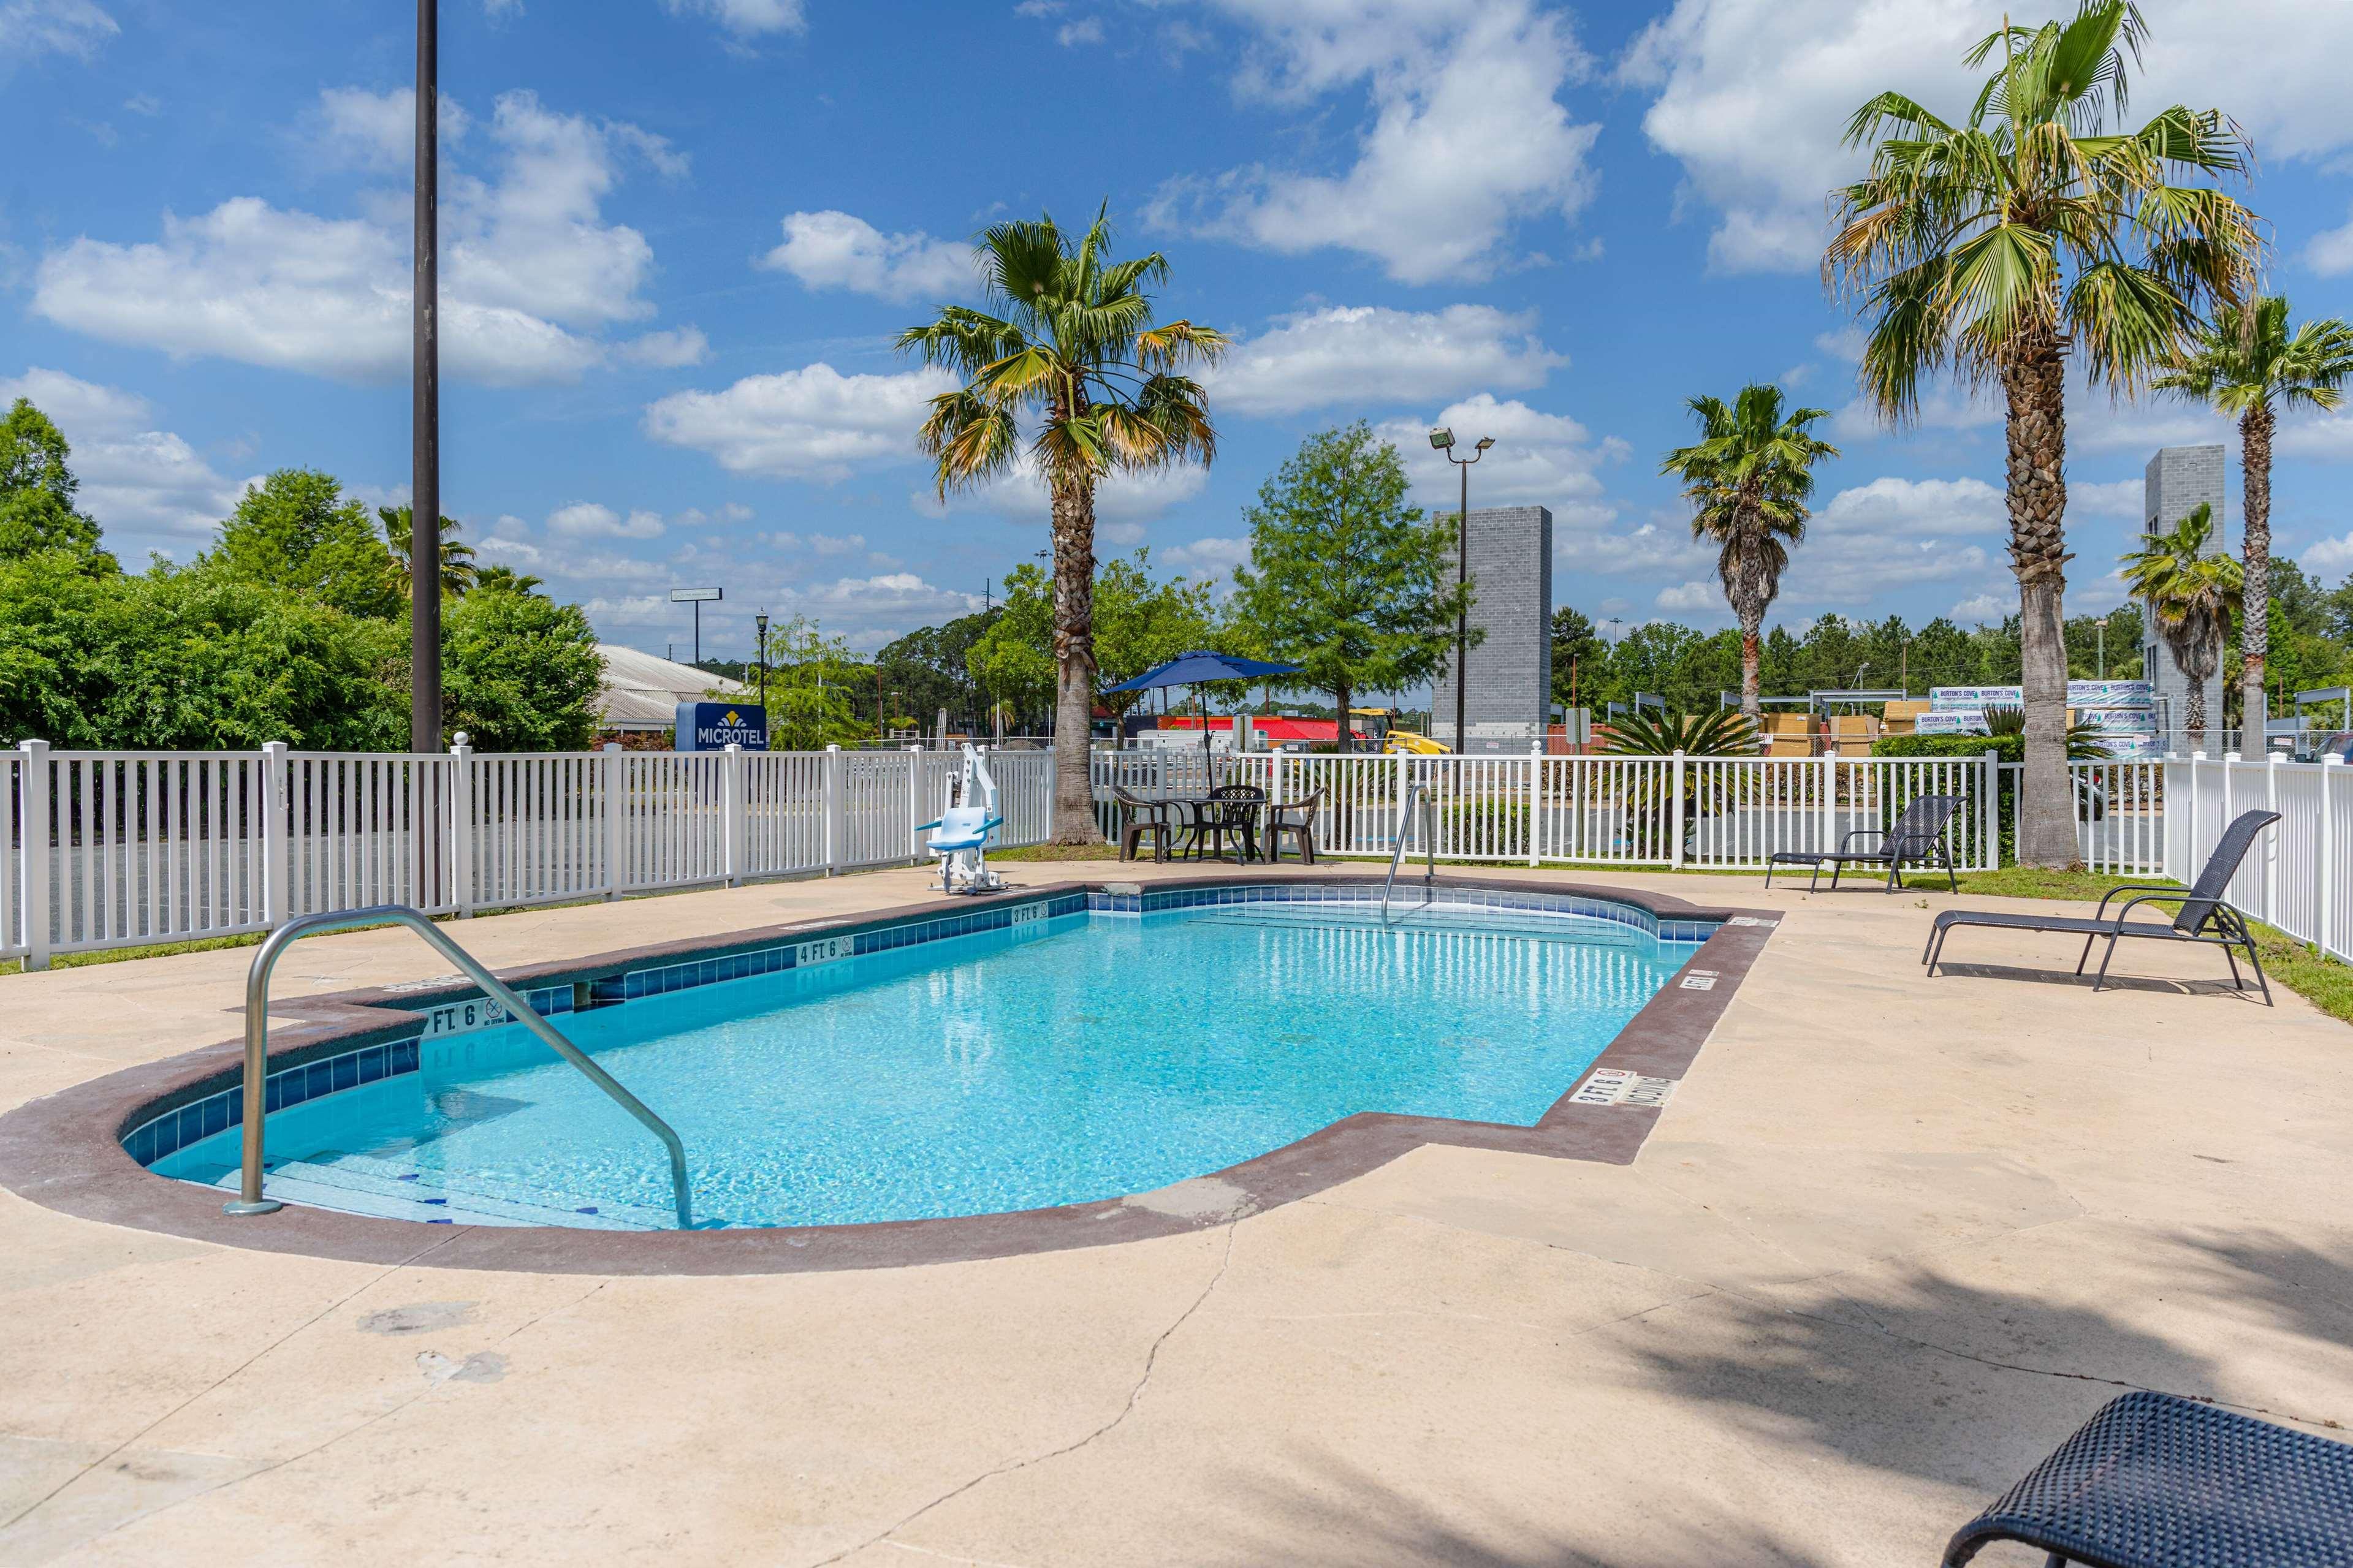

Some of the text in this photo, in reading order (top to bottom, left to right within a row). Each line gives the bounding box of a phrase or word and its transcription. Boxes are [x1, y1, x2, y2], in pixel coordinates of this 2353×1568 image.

[698, 727, 764, 744] MICROTEL
[1014, 910, 1019, 922] 3
[1033, 906, 1037, 918] 6
[800, 945, 808, 962] 4
[829, 941, 836, 956] 6
[433, 1004, 475, 1033] FT. 6
